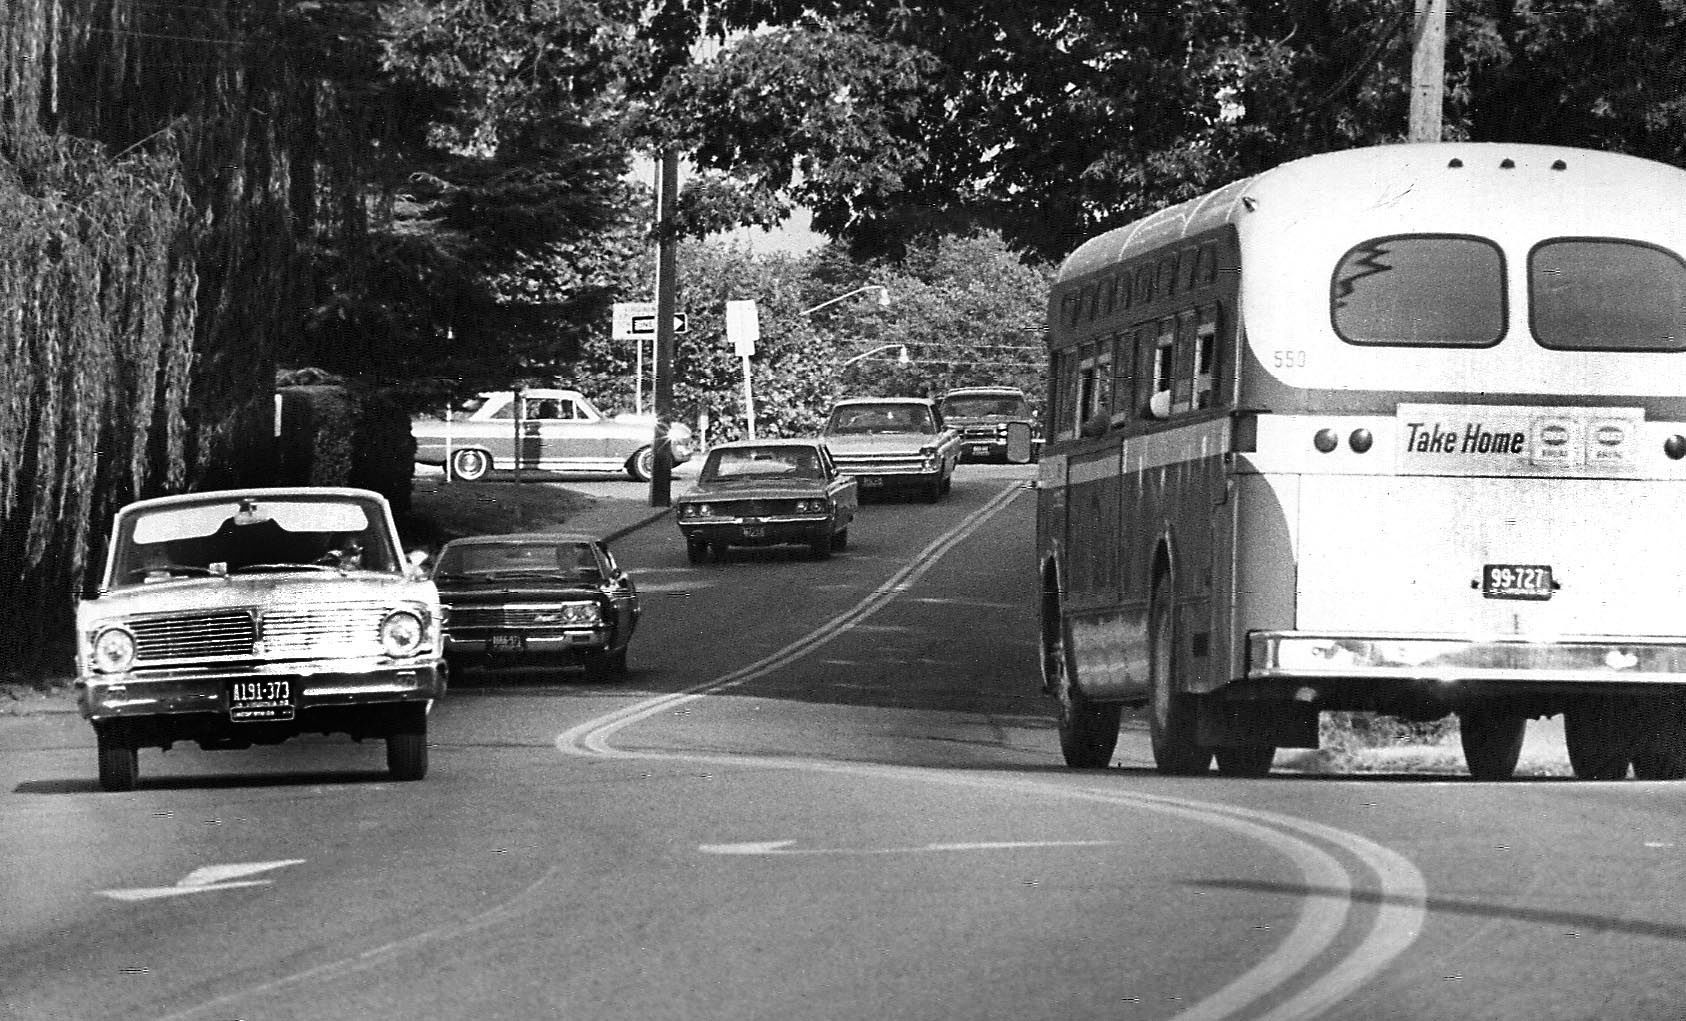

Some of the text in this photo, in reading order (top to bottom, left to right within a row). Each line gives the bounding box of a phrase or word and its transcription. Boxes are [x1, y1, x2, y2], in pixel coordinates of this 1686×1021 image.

[1407, 422, 1525, 453] Take Home
[1491, 568, 1544, 588] 99-727
[233, 681, 290, 700] A191-373
